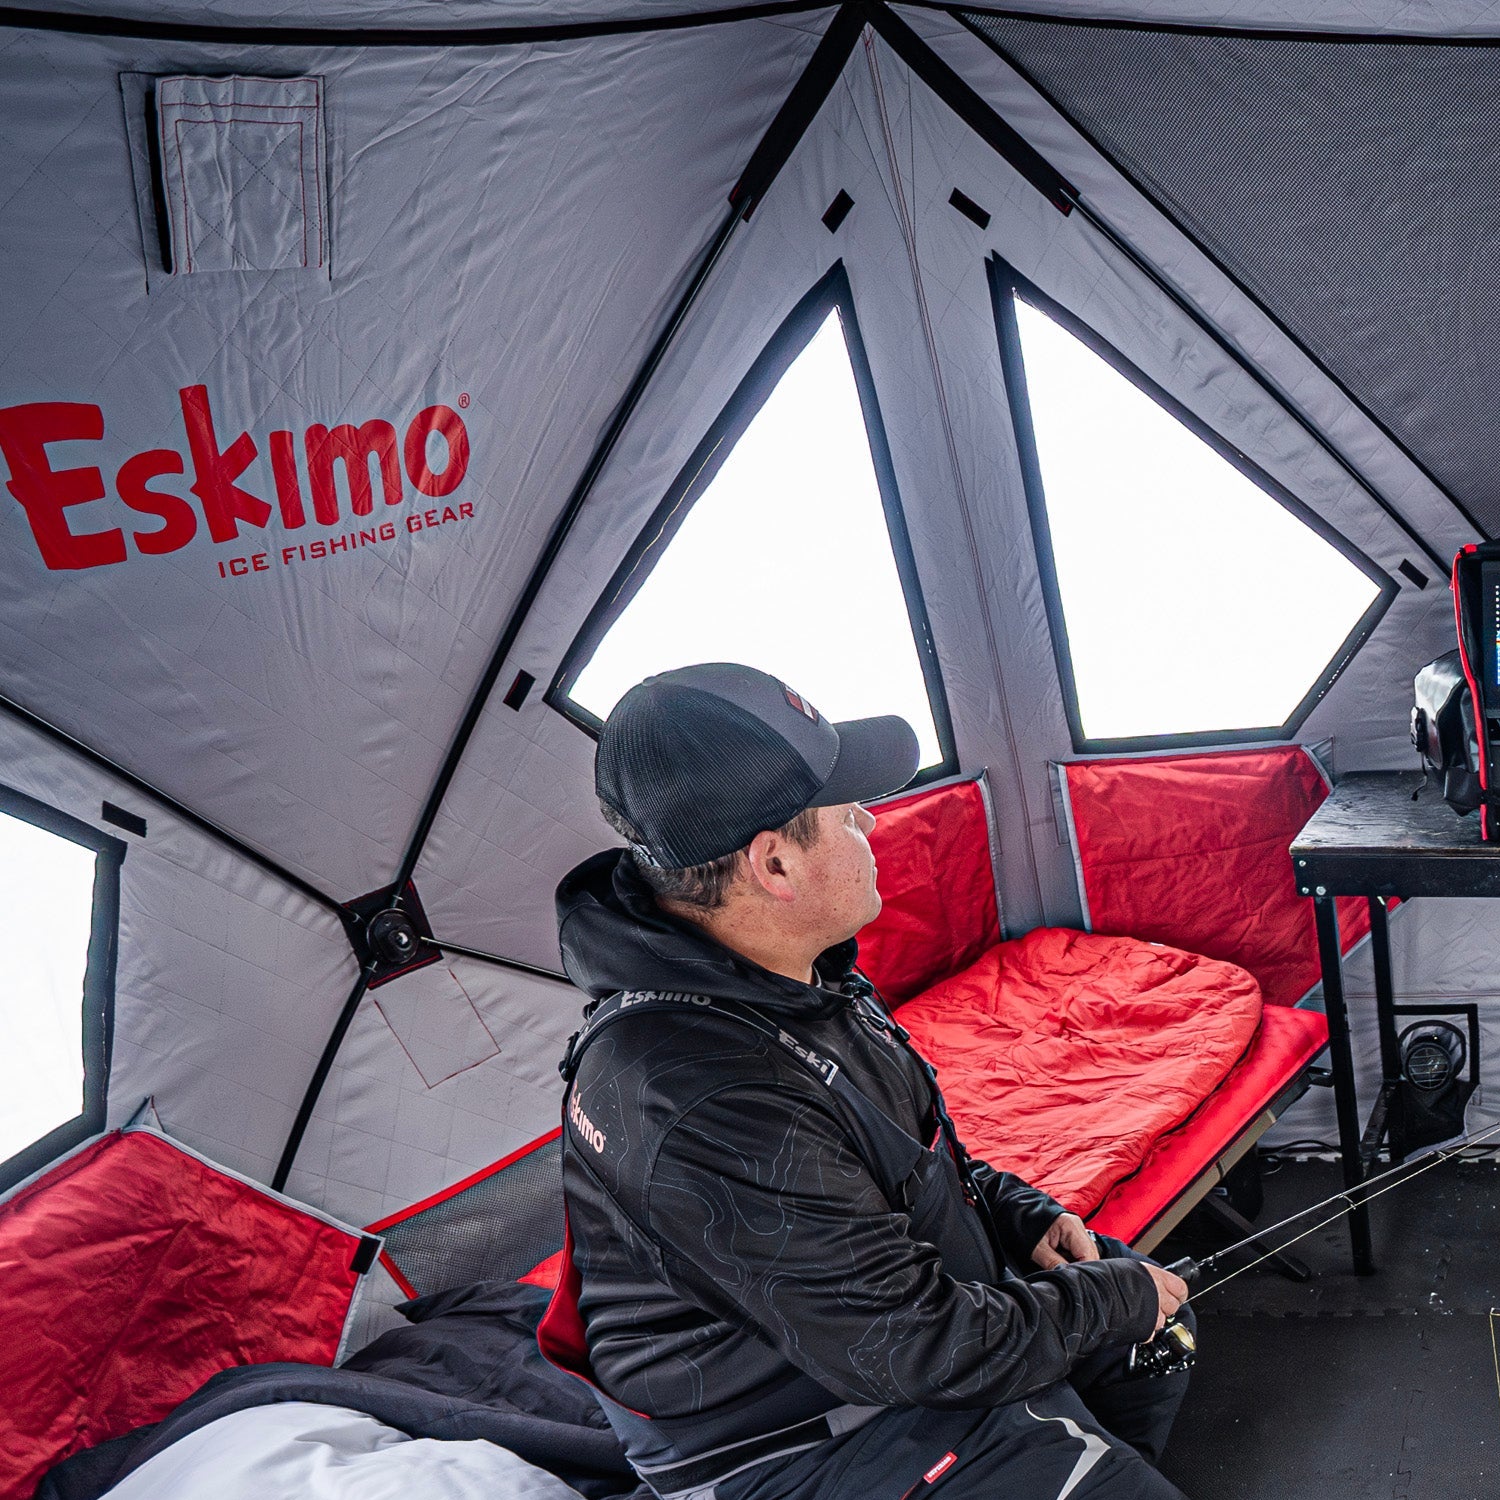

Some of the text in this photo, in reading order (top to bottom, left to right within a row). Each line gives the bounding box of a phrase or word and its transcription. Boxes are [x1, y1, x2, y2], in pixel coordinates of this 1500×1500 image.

[0, 384, 471, 570] Eskimo
[218, 501, 475, 579] ICE FISHING GEAR
